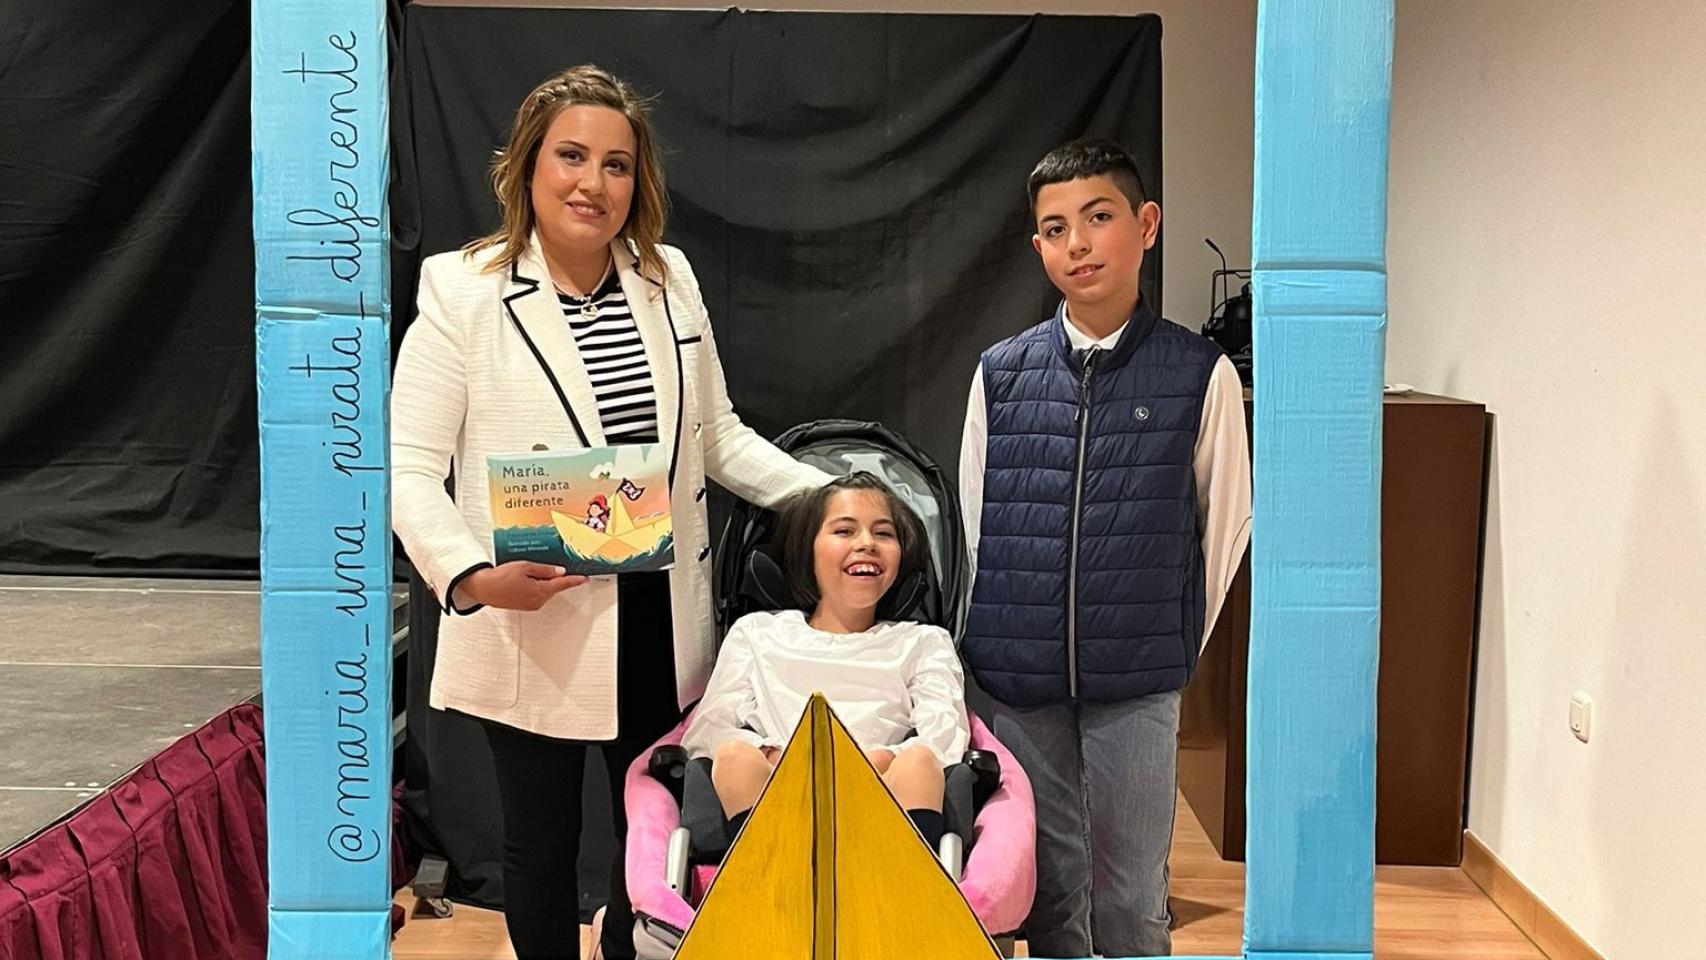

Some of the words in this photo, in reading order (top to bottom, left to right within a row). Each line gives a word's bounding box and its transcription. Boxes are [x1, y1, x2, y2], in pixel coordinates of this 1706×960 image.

[281, 30, 381, 862] @maria_una_pirata_diferente
[503, 484, 528, 494] una
[531, 480, 570, 495] pirata
[504, 496, 564, 509] diferente
